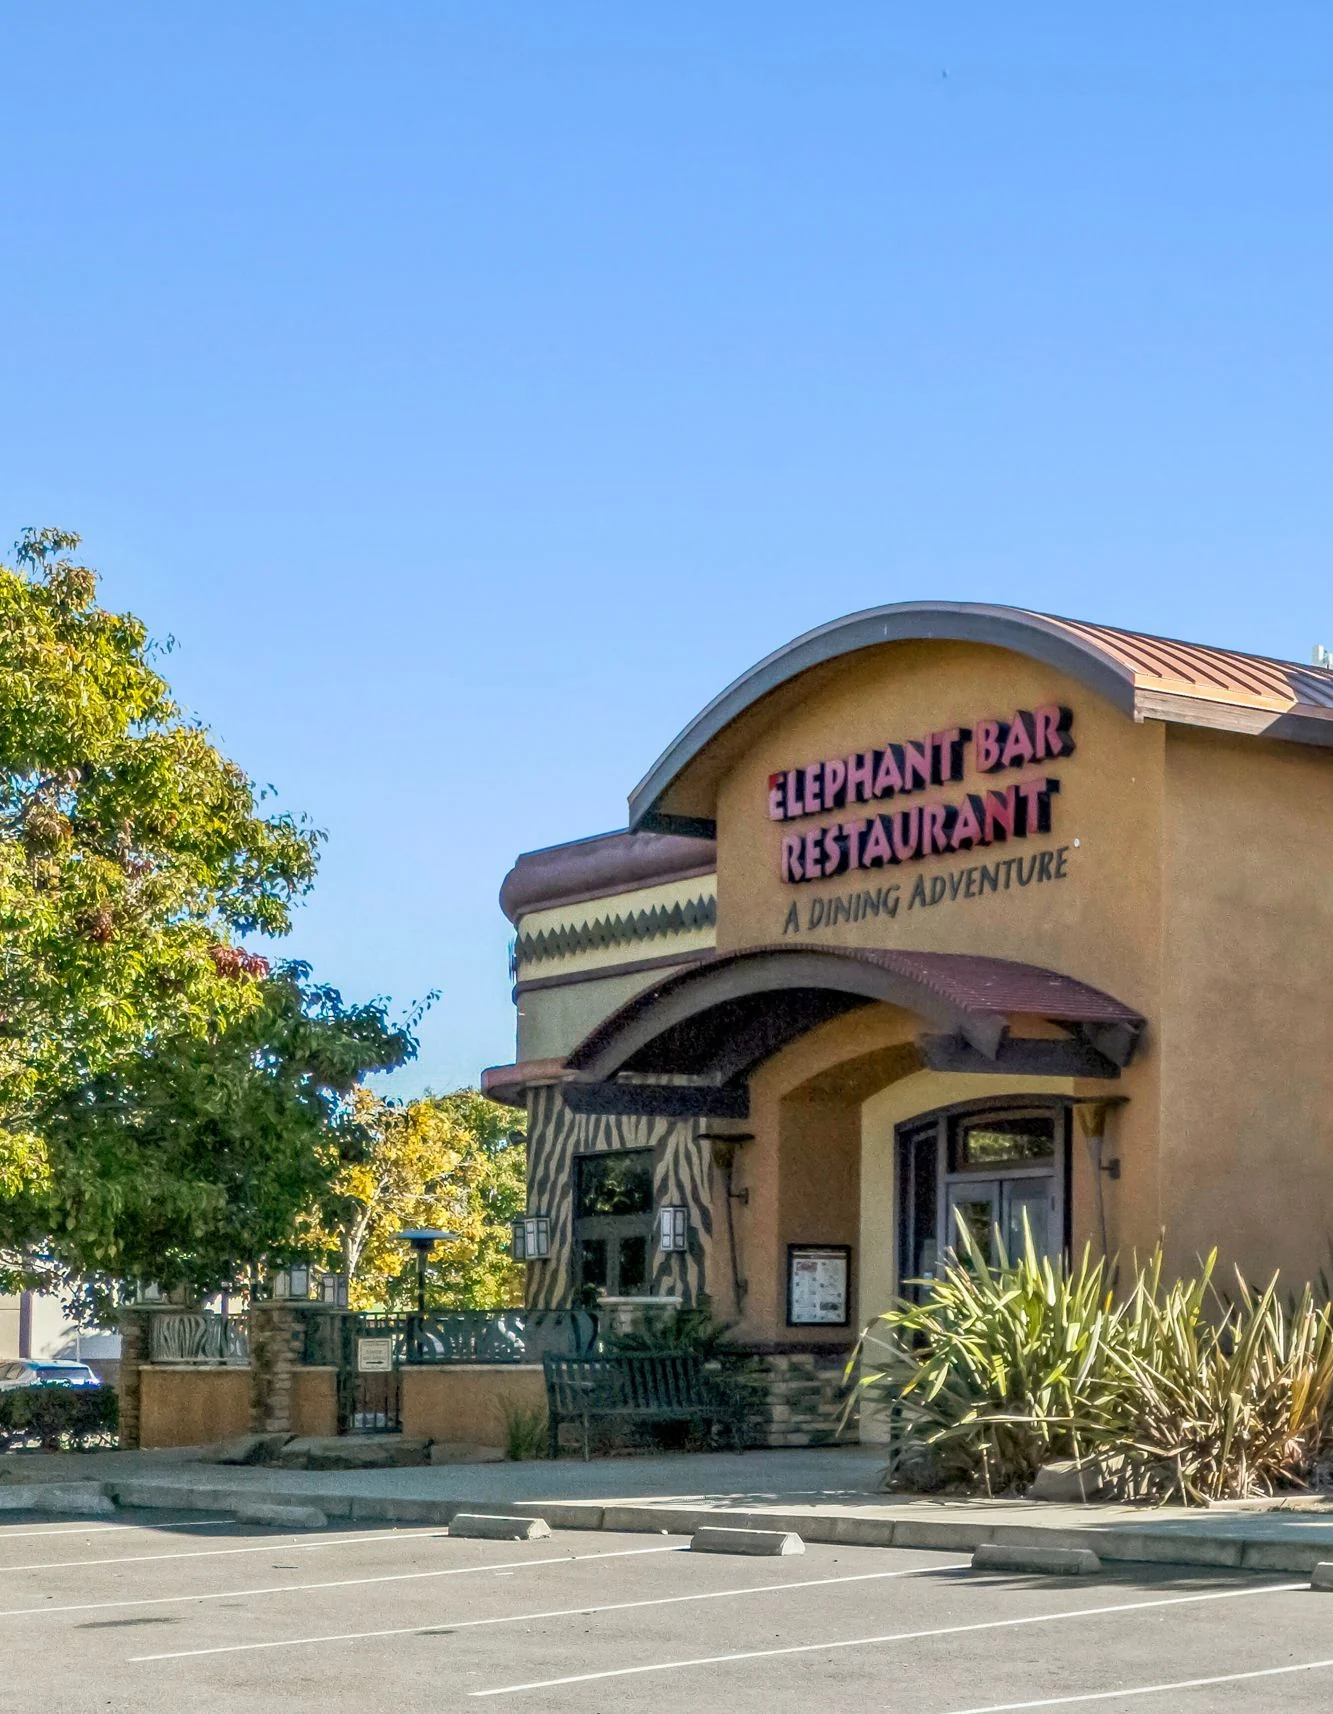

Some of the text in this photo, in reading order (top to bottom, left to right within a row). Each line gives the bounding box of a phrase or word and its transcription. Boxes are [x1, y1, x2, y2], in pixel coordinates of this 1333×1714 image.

[768, 704, 1066, 822] ELEPHANT BAR
[780, 777, 1050, 884] RESTAURANT
[783, 846, 1070, 935] A DINING ADVENTURE
